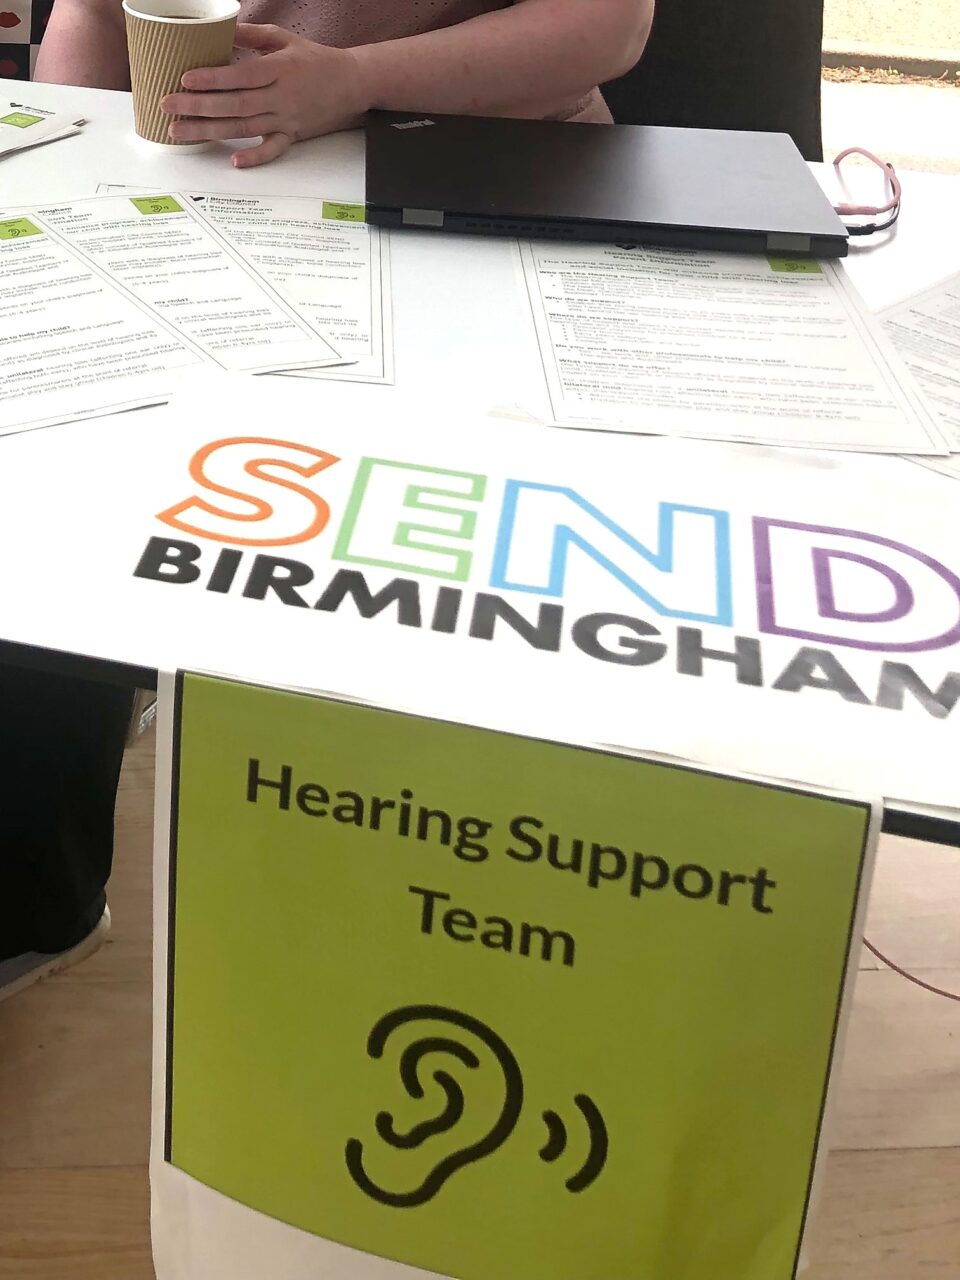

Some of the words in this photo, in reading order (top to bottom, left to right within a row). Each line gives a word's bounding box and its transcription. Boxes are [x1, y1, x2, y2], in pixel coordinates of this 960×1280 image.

[132, 535, 960, 721] BIRMINGHAM
[154, 435, 960, 654] SEND
[245, 757, 493, 863] Hearing
[505, 815, 777, 914] Support
[408, 884, 577, 967] Team
